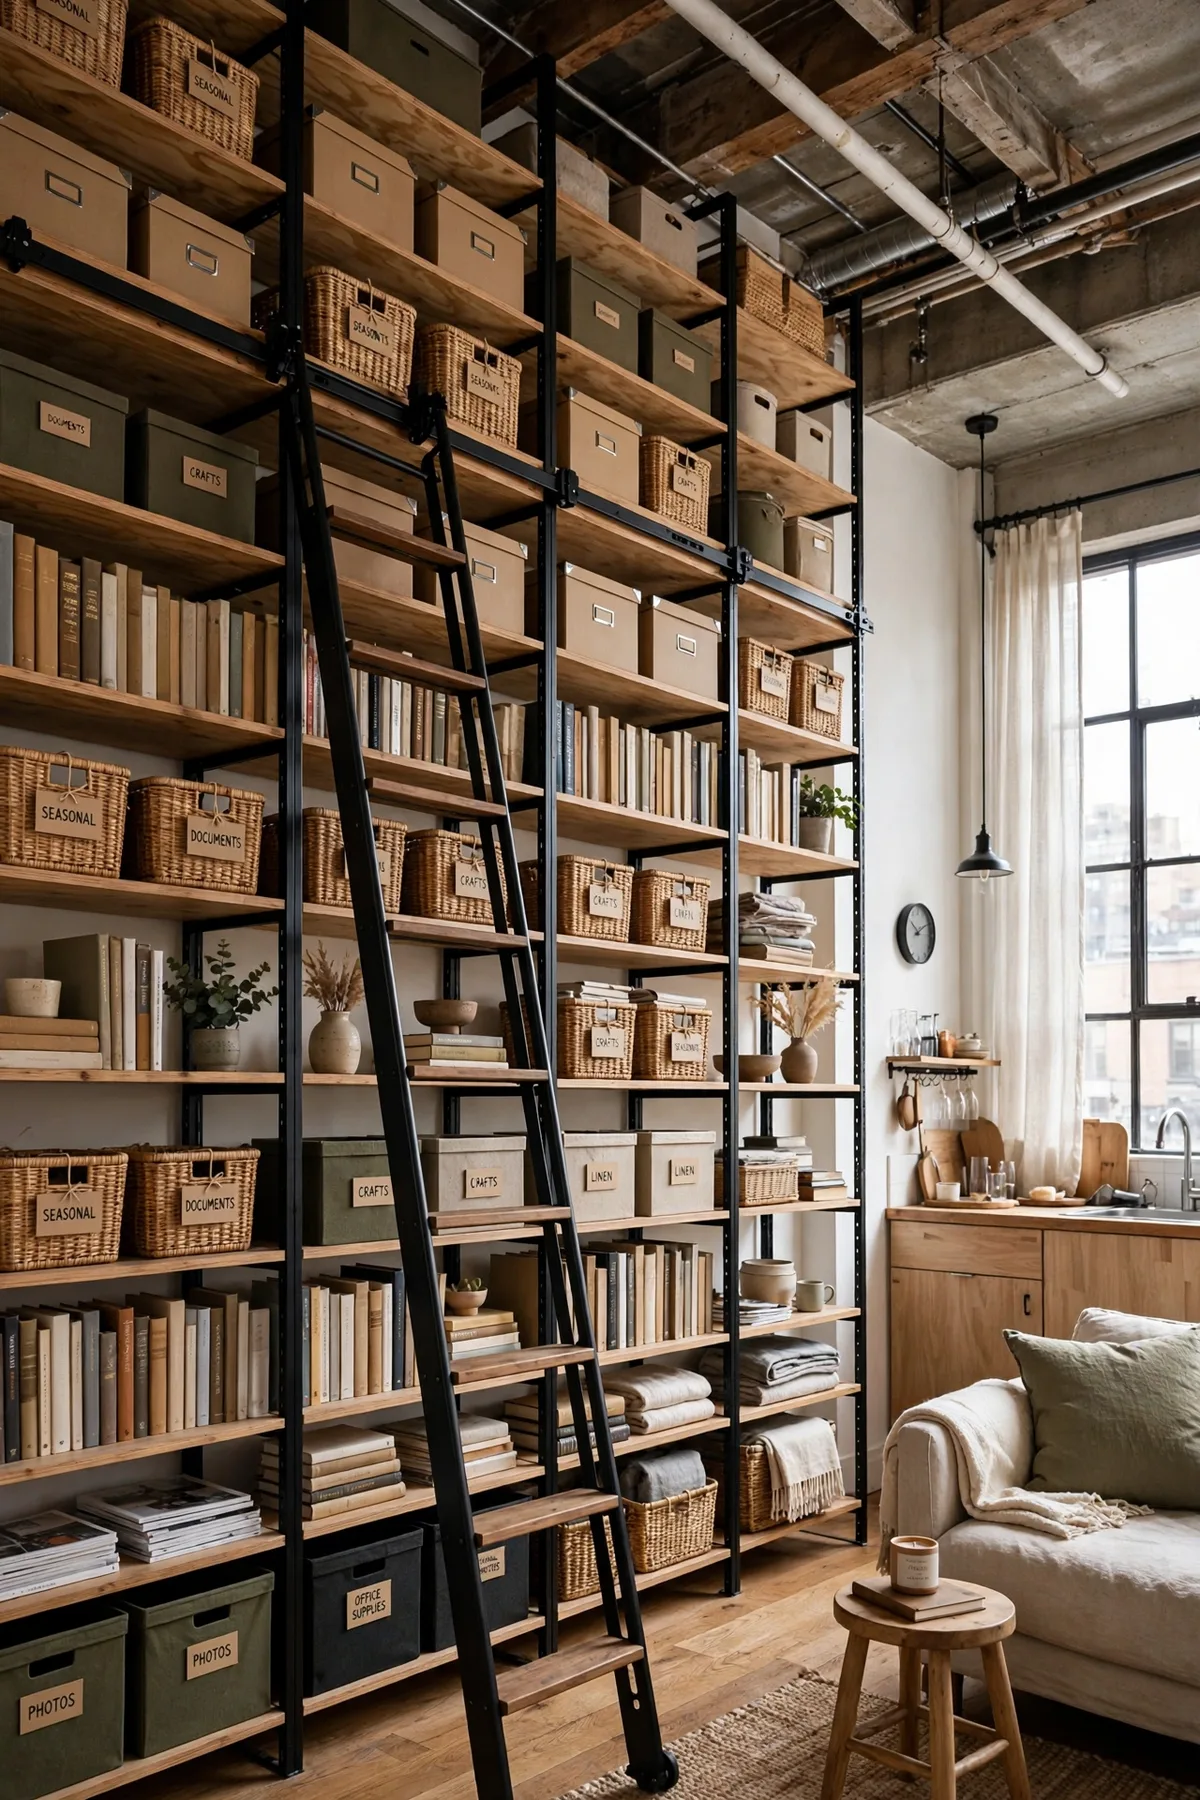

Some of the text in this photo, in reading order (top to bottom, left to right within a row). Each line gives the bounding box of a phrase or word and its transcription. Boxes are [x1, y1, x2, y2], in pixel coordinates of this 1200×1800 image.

[49, 0, 90, 23] ASONAL
[194, 75, 233, 107] SEASONAL
[189, 466, 221, 487] CRAFTS
[42, 806, 97, 827] SEASONAL
[190, 829, 242, 849] DOCUMENTS
[460, 874, 487, 890] CRAFTS
[593, 895, 618, 909] CRAFTS
[591, 1170, 613, 1183] LINEN
[675, 1165, 695, 1177] LINEN
[358, 1185, 389, 1198] CRAFTS
[470, 1176, 499, 1189] CRAFTS
[185, 1197, 235, 1212] DOCUMENTS
[43, 1206, 96, 1222] SEASONAL
[355, 1588, 381, 1607] OFFICE
[352, 1602, 386, 1620] SUPPLIES
[193, 1643, 231, 1667] PHOTOS
[28, 1692, 75, 1720] PHOTOS
